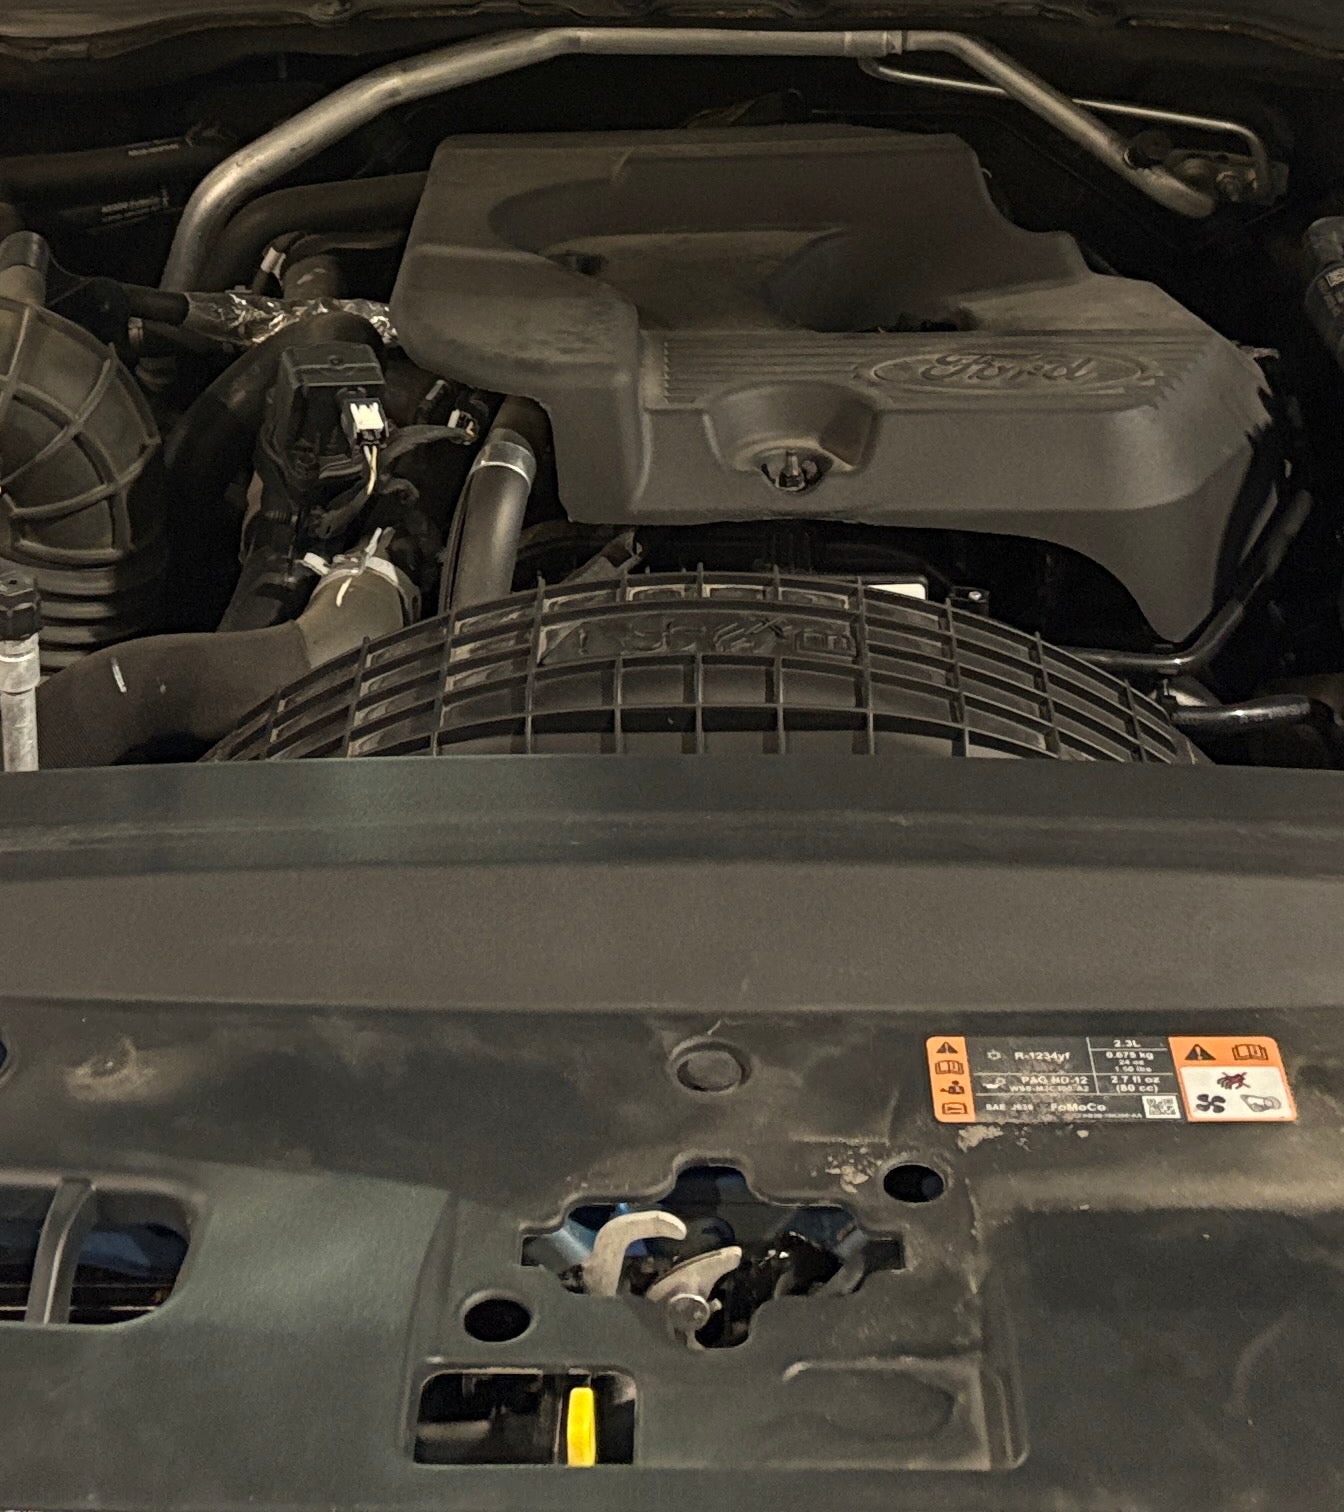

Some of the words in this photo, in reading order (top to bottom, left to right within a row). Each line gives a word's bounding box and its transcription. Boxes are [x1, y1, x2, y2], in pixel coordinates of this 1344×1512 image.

[920, 352, 1097, 381] Ford
[1113, 1039, 1141, 1048] 2.3L
[1014, 1051, 1071, 1064] R-1234yf
[1138, 1051, 1155, 1061] kg
[1050, 1102, 1107, 1112] FoMoCo
